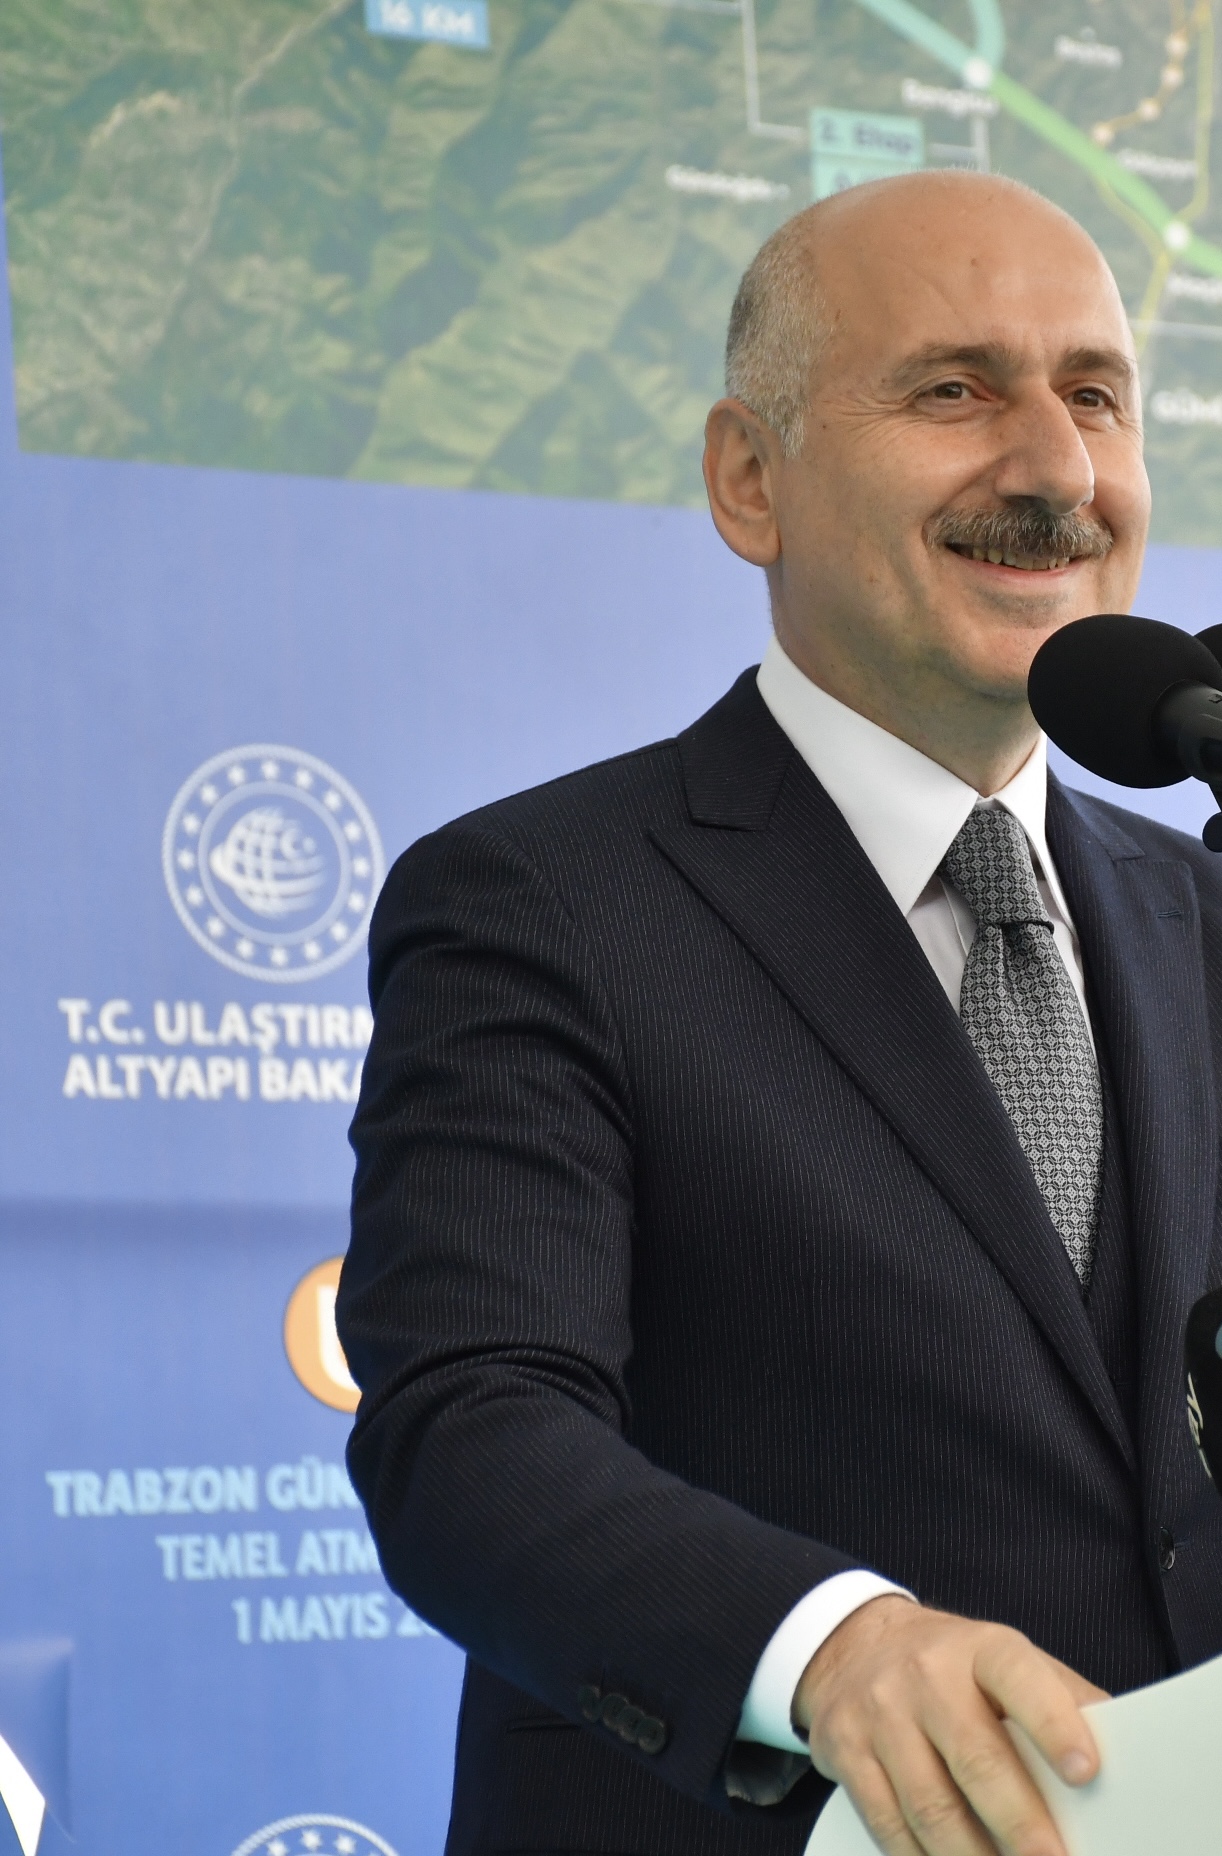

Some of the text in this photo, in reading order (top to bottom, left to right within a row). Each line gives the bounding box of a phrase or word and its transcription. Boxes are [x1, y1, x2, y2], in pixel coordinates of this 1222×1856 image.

[58, 997, 146, 1045] T.C.
[62, 1052, 250, 1101] ALTYAPI
[45, 1465, 258, 1518] TRABZON
[154, 1531, 288, 1582] TEMEL
[230, 1596, 252, 1645] 1
[258, 1591, 389, 1642] MAYIS
